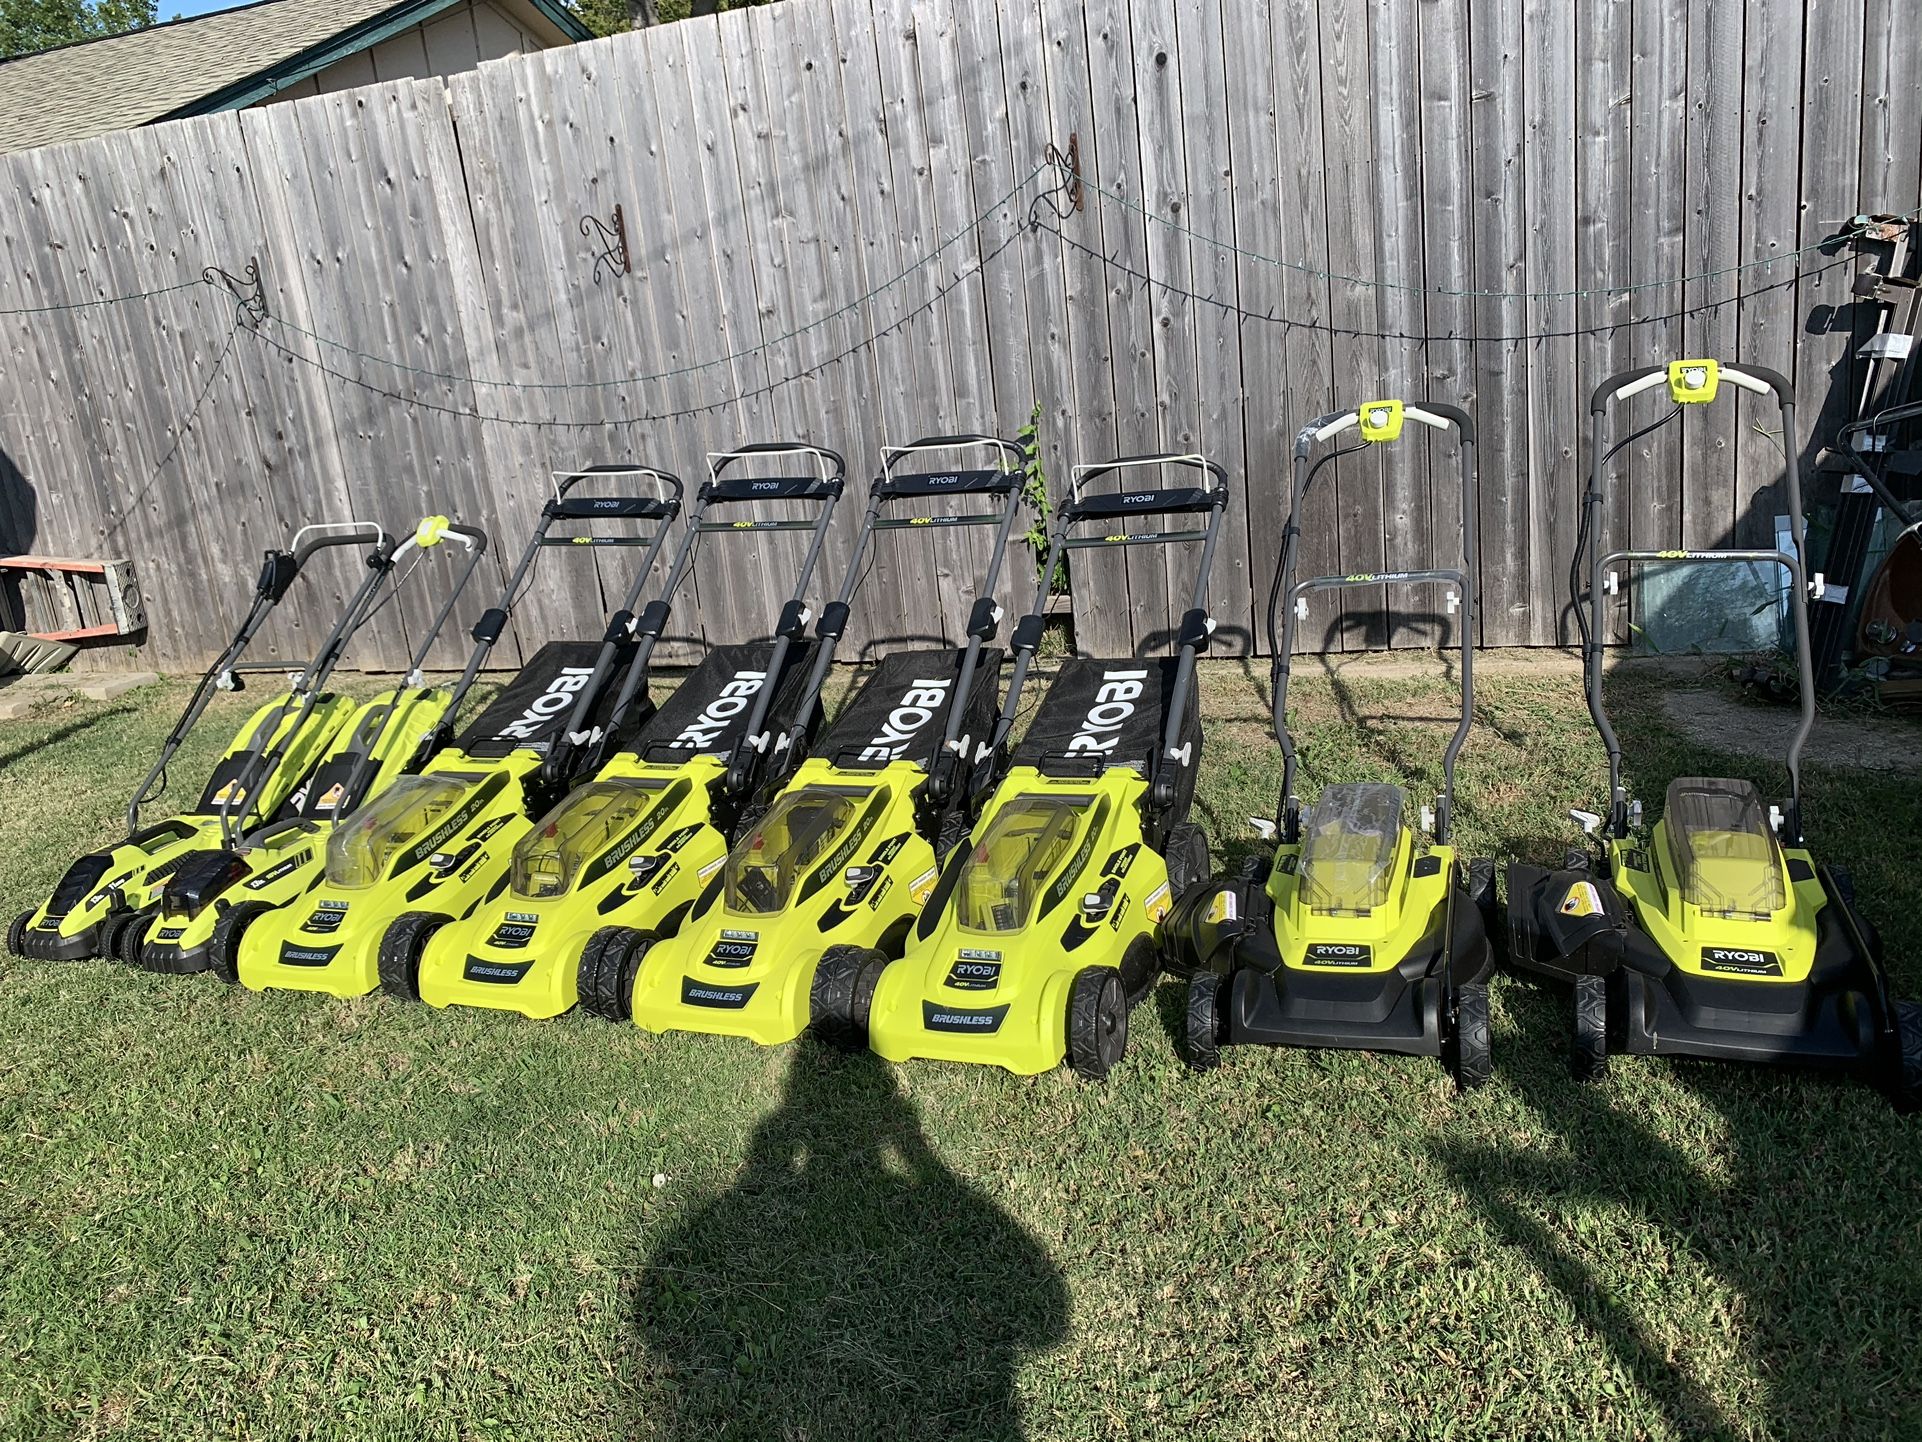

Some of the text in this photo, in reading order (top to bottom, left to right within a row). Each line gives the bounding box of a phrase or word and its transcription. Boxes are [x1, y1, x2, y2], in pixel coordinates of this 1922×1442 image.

[751, 482, 780, 490] RYOBI
[928, 476, 958, 485] RYOBI
[1123, 495, 1155, 503] RYOBI
[492, 667, 595, 740] RYOBI
[669, 671, 767, 749] RYOBI
[1064, 670, 1148, 758] RYOBI
[857, 679, 951, 761] RYOBI
[414, 809, 469, 860] BRUSHLESS
[604, 817, 655, 870] BRUSHLESS
[818, 830, 862, 884] BRUSHLESS
[1056, 838, 1092, 898] BRUSHLESS
[40, 919, 60, 927] RYOB
[312, 912, 343, 922] RYOBI
[499, 926, 532, 936] RYOBI
[284, 950, 329, 960] BRUSHLESS
[716, 944, 753, 955] RYOBI
[1316, 945, 1360, 955] RYOBI
[1712, 949, 1765, 963] RYOBI
[470, 965, 519, 977] BRUSHLESS
[956, 964, 996, 975] RYOBI
[688, 988, 743, 1001] BRUSHLESS
[931, 1013, 994, 1025] BRUSHLESS
